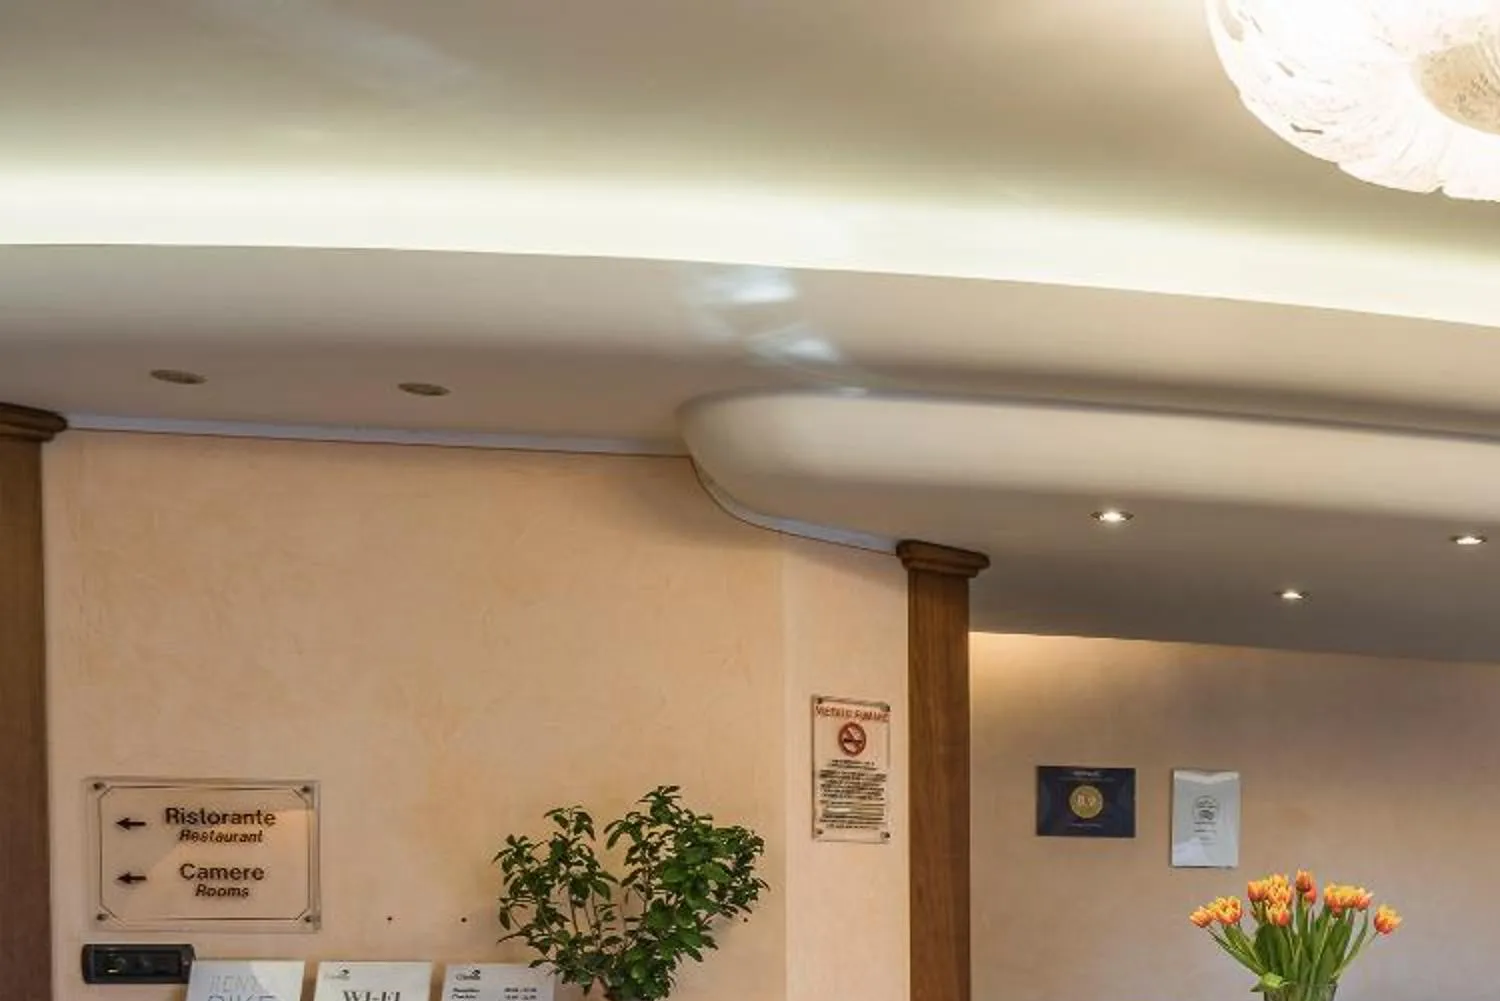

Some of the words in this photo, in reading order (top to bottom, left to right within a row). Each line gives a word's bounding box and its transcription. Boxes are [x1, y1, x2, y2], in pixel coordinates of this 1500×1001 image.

[165, 807, 276, 827] Ristorante
[179, 829, 263, 843] Restaurant
[179, 863, 265, 881] Camere
[195, 884, 249, 898] Rooms
